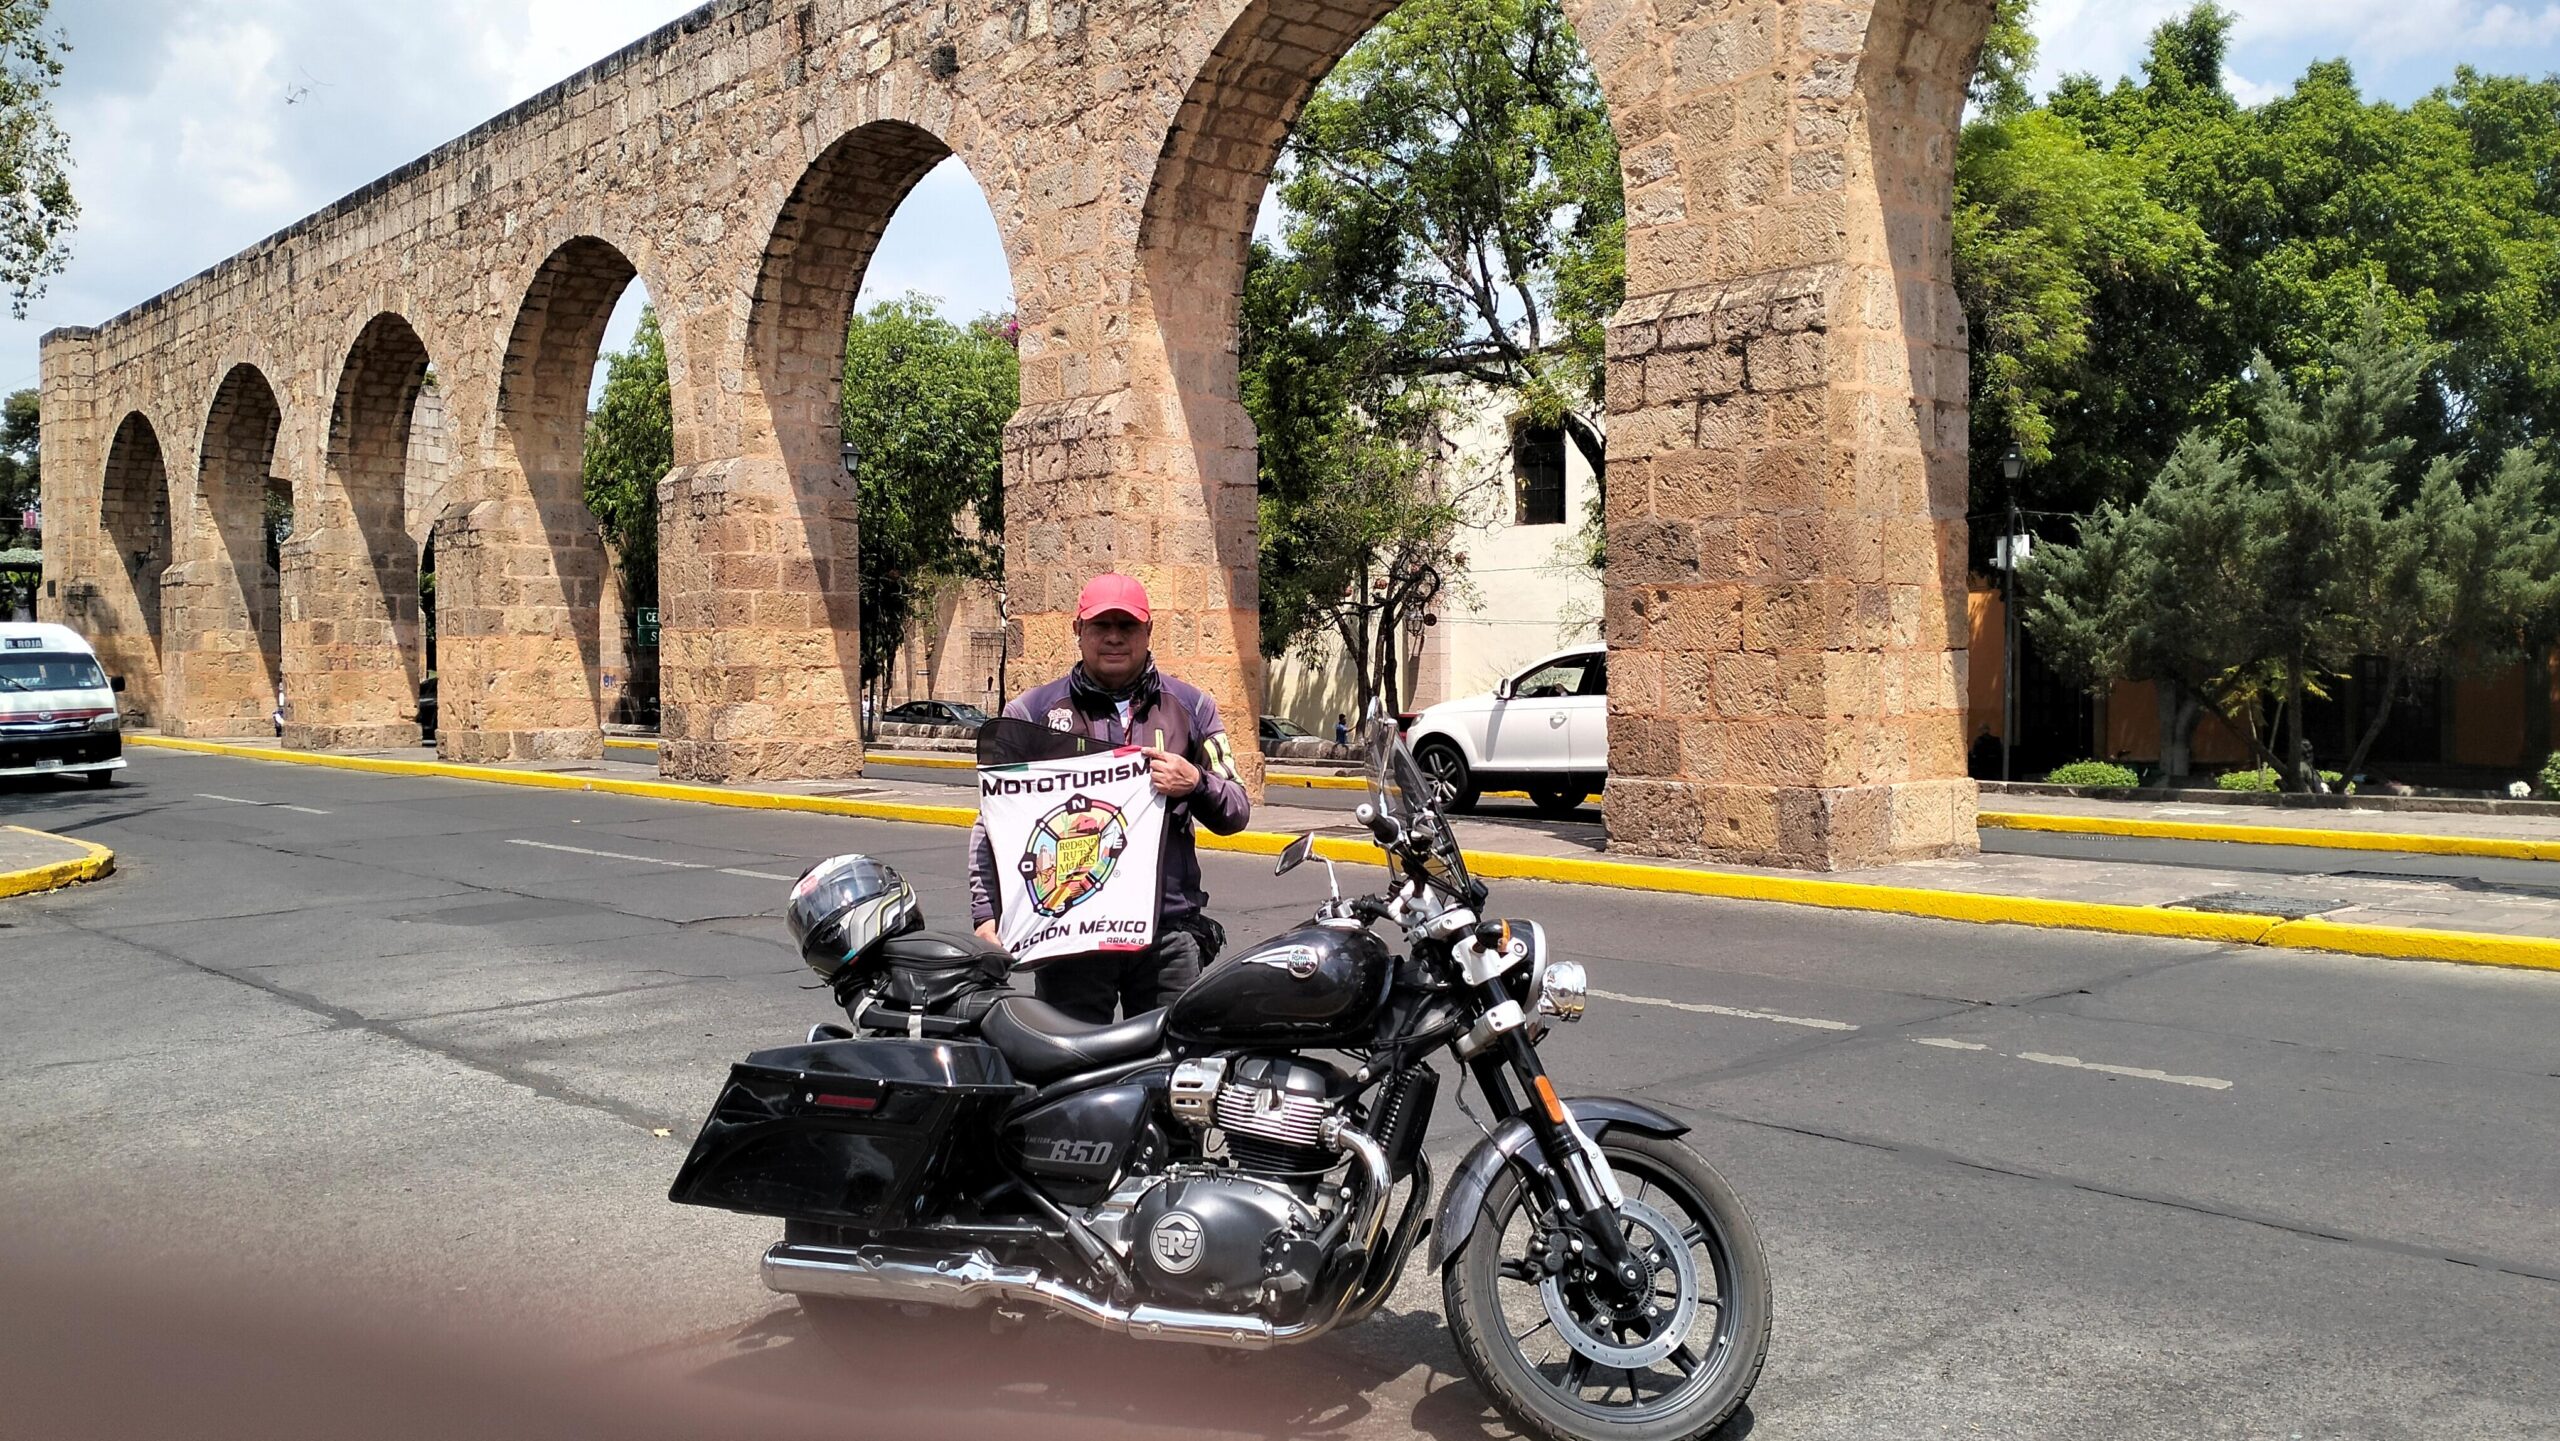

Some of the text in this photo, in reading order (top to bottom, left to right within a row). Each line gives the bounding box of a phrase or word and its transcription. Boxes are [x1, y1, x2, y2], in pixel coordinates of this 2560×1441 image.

[646, 612, 657, 622] CE
[651, 631, 657, 641] S
[1051, 718, 1070, 732] 66
[982, 761, 1150, 797] MOTOTURISM
[1071, 799, 1086, 809] N
[1079, 915, 1147, 934] MÉXICO
[1050, 1139, 1113, 1165] 650
